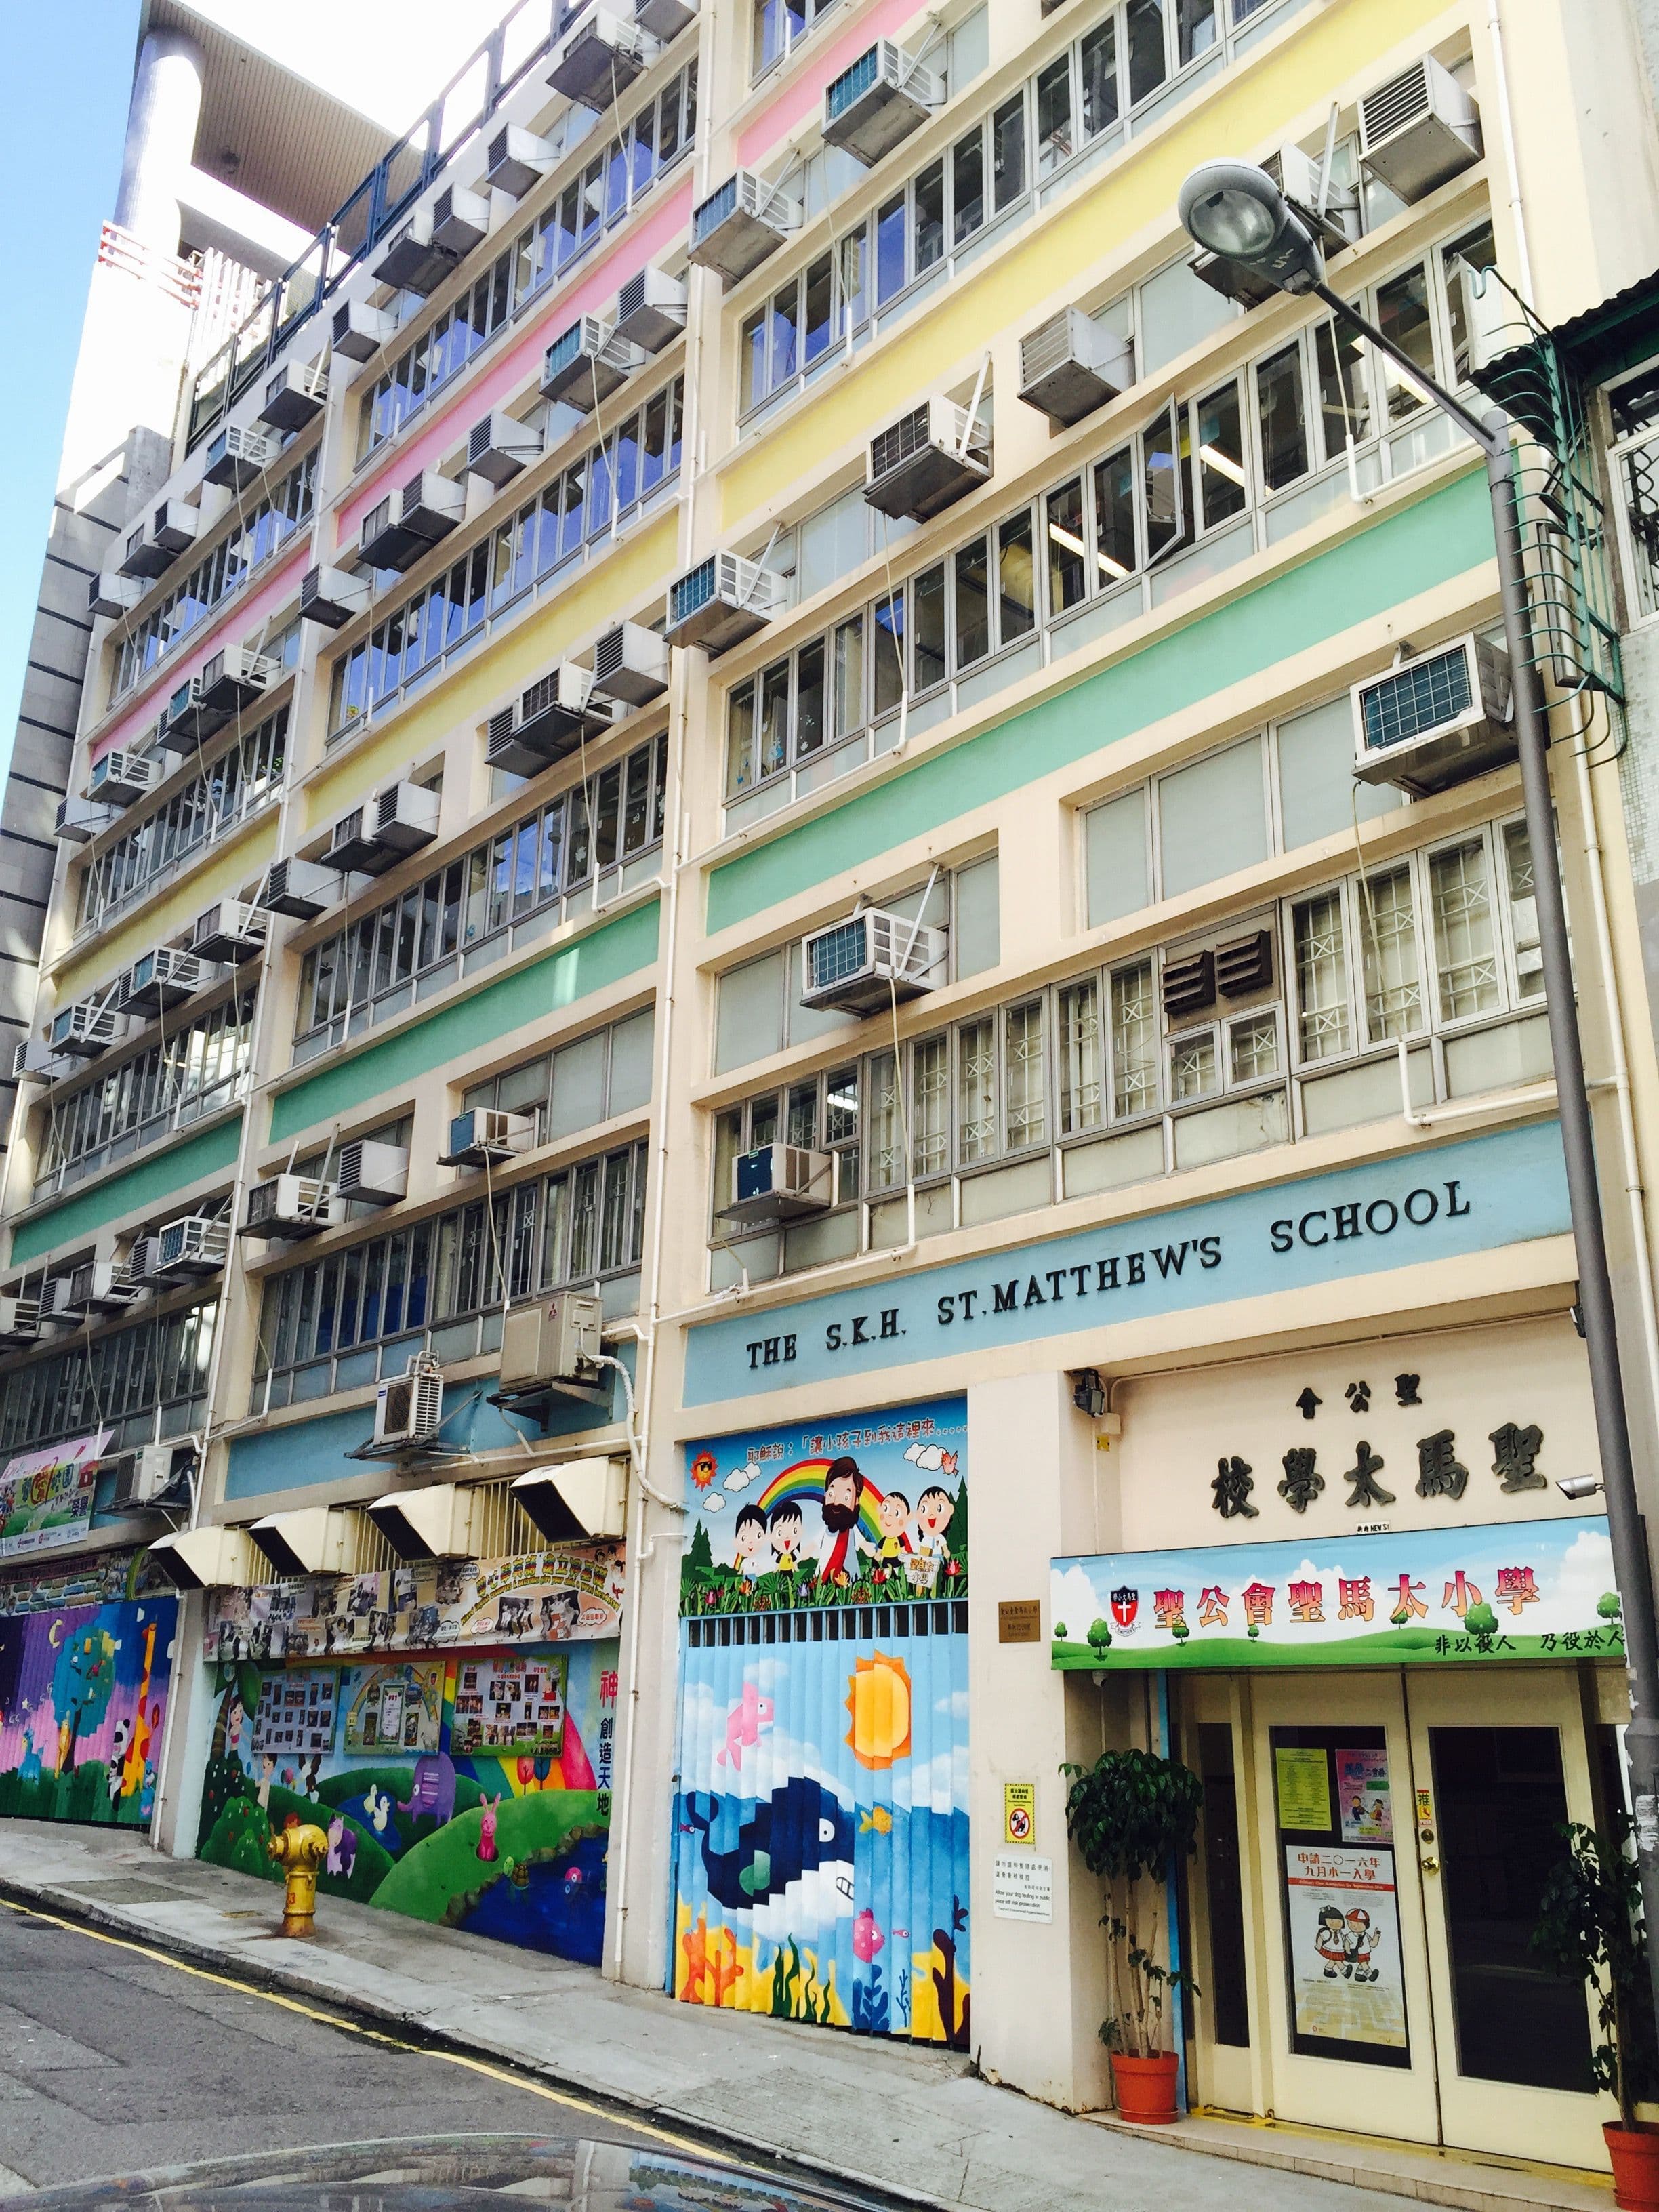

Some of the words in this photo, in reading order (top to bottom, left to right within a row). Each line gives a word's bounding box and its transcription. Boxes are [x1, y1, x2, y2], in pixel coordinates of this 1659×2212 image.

[746, 1333, 797, 1369] THE
[825, 1308, 906, 1351] S.K.H.
[1270, 1180, 1471, 1252] SCHOOL
[1153, 1565, 1540, 1629] 聖公會聖馬太小學
[1435, 1633, 1517, 1656] 非以役人
[1540, 1629, 1626, 1652] 乃役於人
[1418, 1793, 1430, 1806] 推
[1305, 1866, 1376, 1881] 九月小一入學
